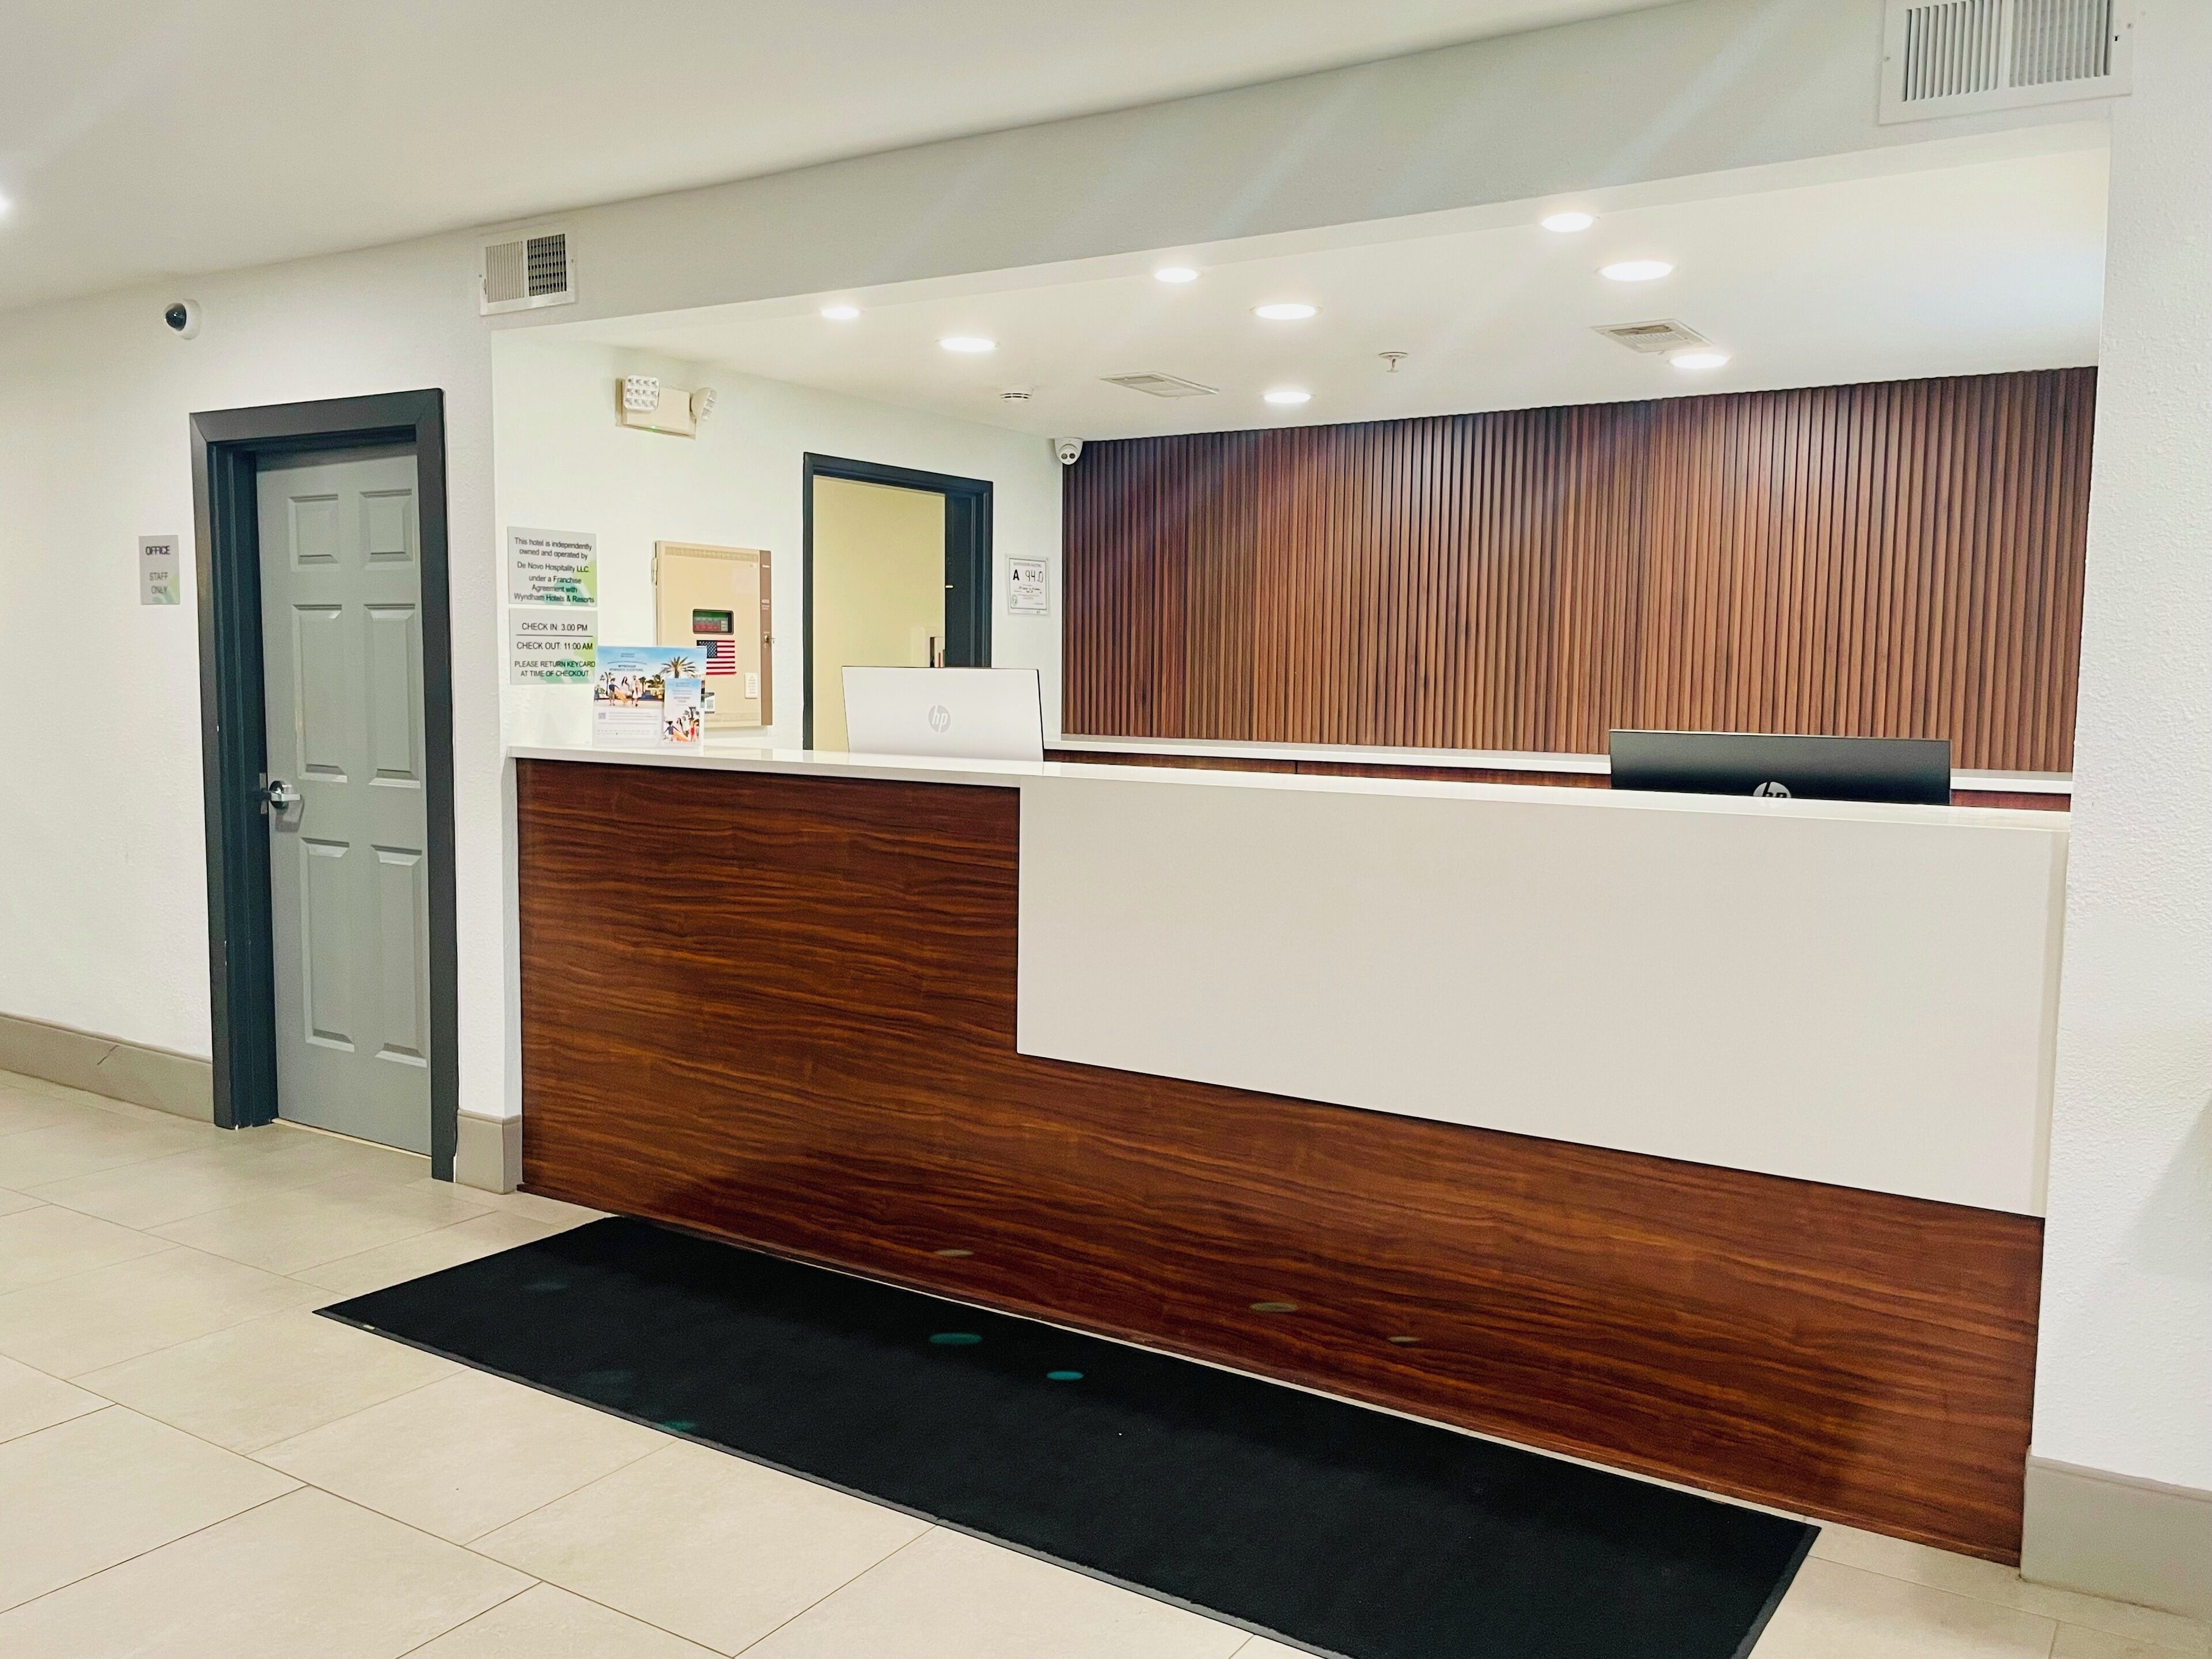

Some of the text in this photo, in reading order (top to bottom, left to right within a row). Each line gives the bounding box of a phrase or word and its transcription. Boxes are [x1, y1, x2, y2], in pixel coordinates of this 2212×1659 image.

[514, 537, 528, 545] This
[552, 541, 592, 551] independently
[145, 546, 171, 555] OFFICE
[517, 561, 527, 569] De
[545, 563, 575, 573] Hospitality
[149, 572, 168, 581] STAFF
[1013, 569, 1020, 581] A
[553, 576, 582, 584] Franchise
[151, 586, 168, 594] ONLY
[532, 584, 578, 593] Agreement with
[514, 593, 544, 601] Wyndham
[573, 595, 594, 603] Resorts
[522, 623, 548, 631] CHECK
[517, 642, 543, 650] CHECK
[930, 704, 949, 733] hp
